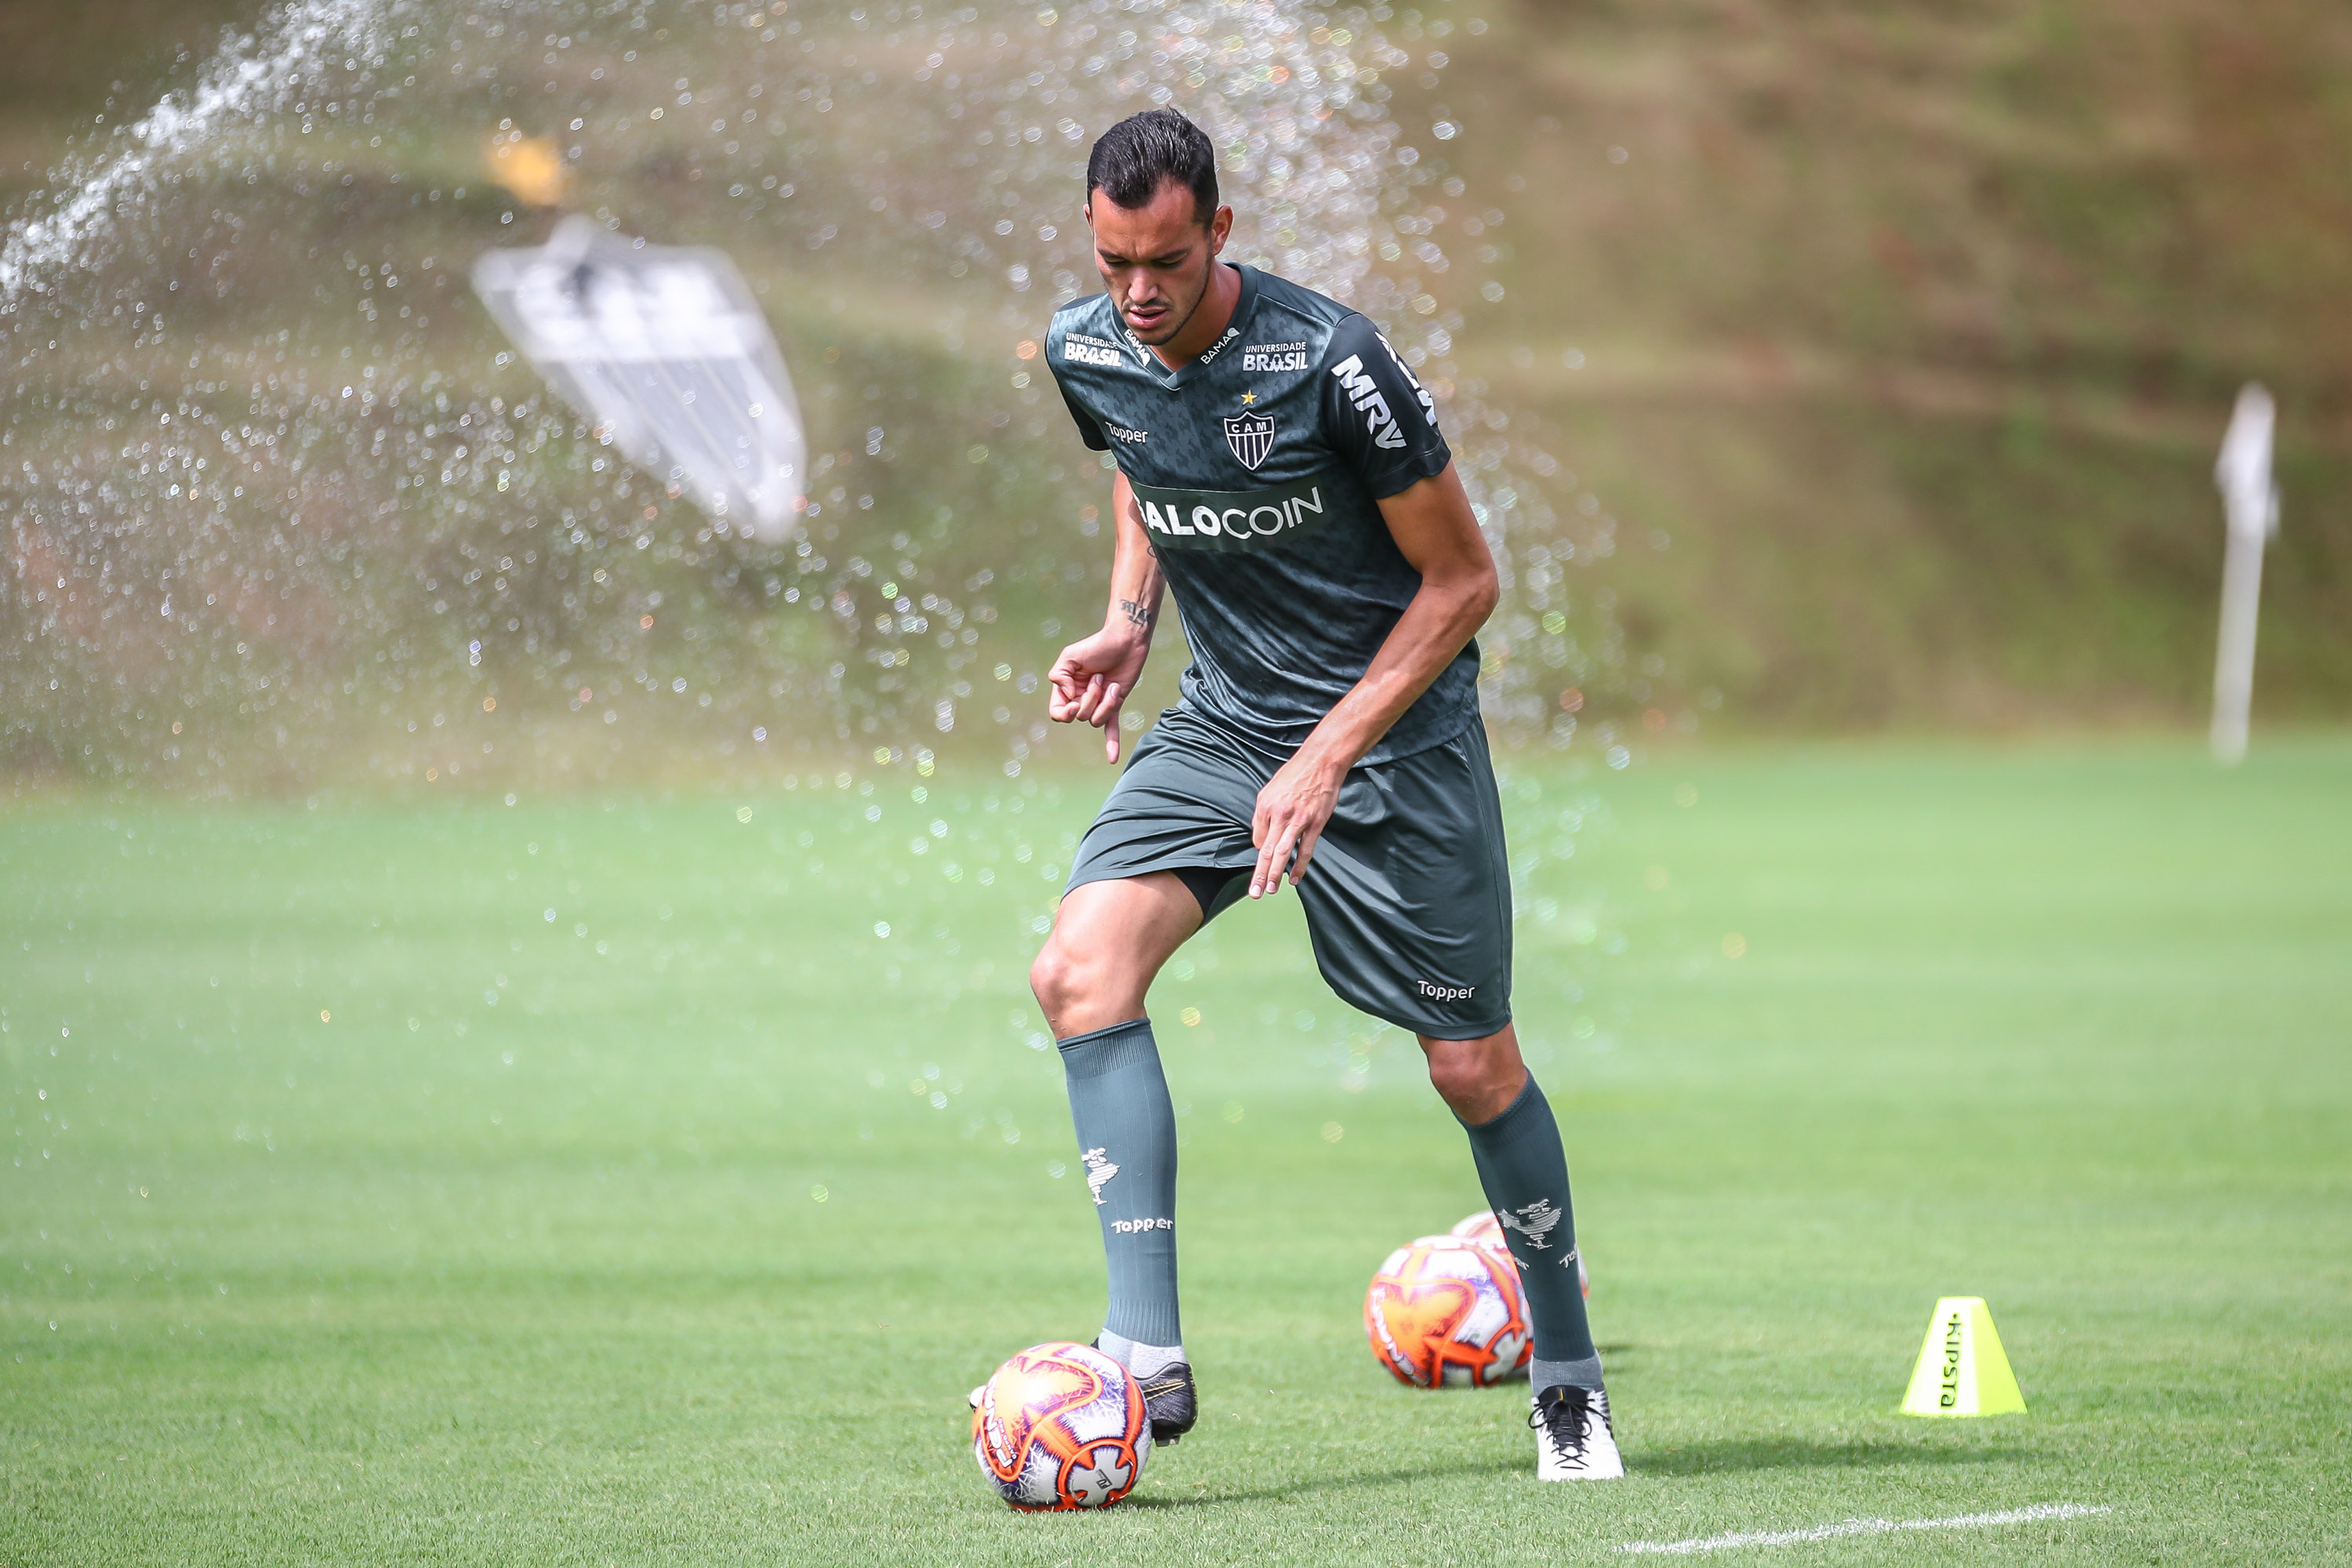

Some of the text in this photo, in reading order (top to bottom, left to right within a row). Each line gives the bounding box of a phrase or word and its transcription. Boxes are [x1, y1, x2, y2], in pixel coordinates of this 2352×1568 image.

[1066, 332, 1118, 350] UNIVERSIDADE
[1245, 342, 1307, 354] UNIVERSIDADE
[1064, 342, 1123, 367] BRASIL
[1243, 352, 1308, 373] BRASIL
[1330, 354, 1407, 449] MRV
[1105, 421, 1149, 445] Topper
[1231, 422, 1267, 433] CAM
[1132, 486, 1324, 540] ALOCOIN
[1417, 980, 1475, 1002] Topper
[1110, 1218, 1174, 1234] Topper
